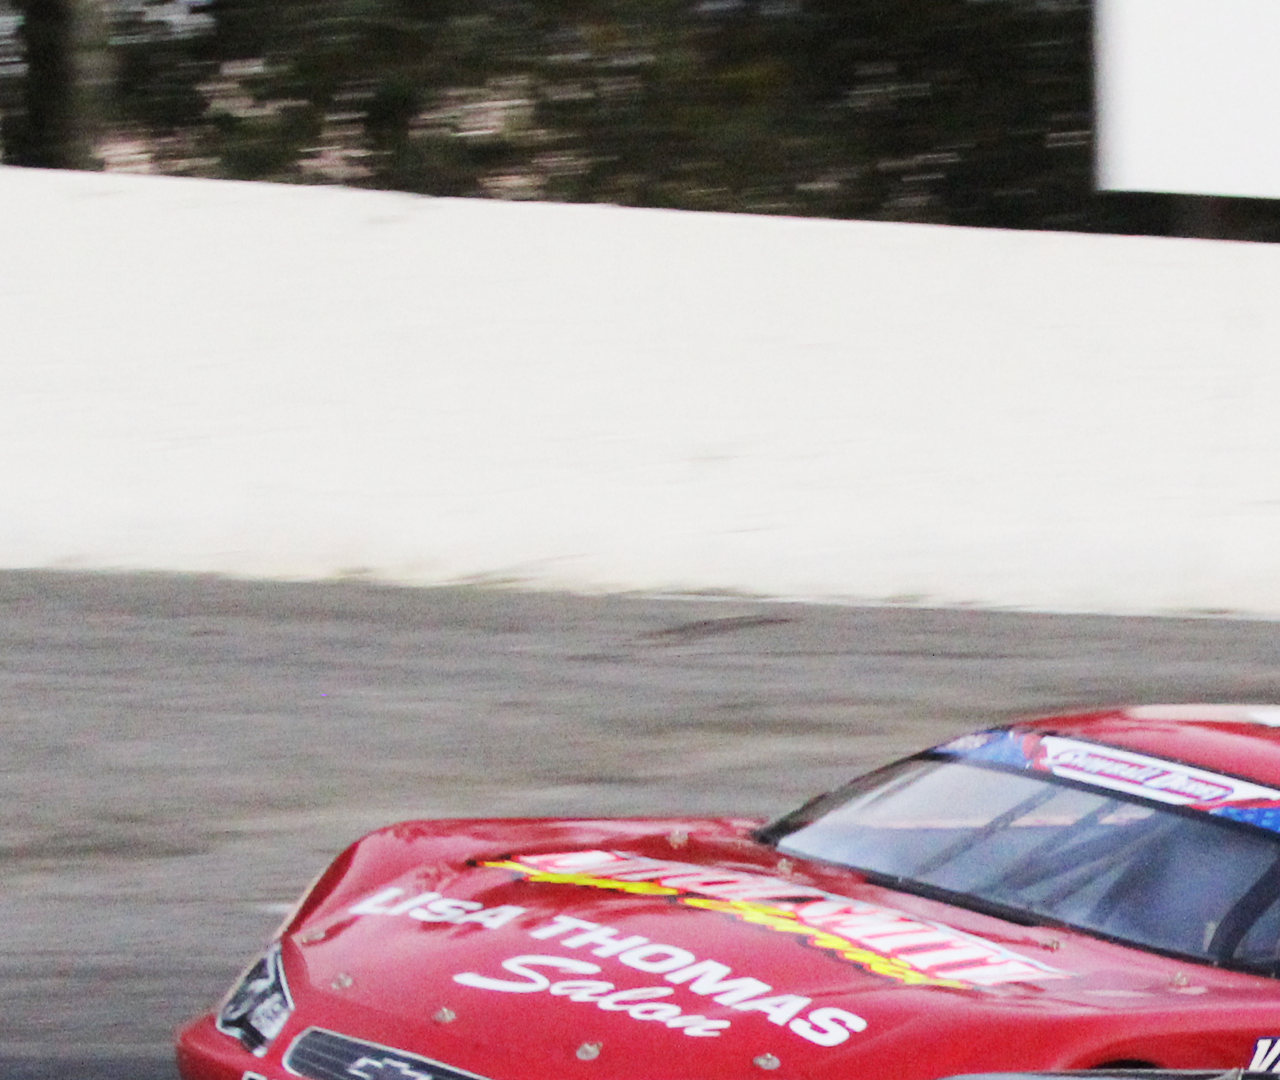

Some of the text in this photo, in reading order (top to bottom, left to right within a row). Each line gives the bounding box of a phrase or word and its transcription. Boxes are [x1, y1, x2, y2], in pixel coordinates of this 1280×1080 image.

[346, 887, 525, 929] LISA
[531, 914, 869, 1047] THOMAS
[453, 954, 732, 1039] Salon
